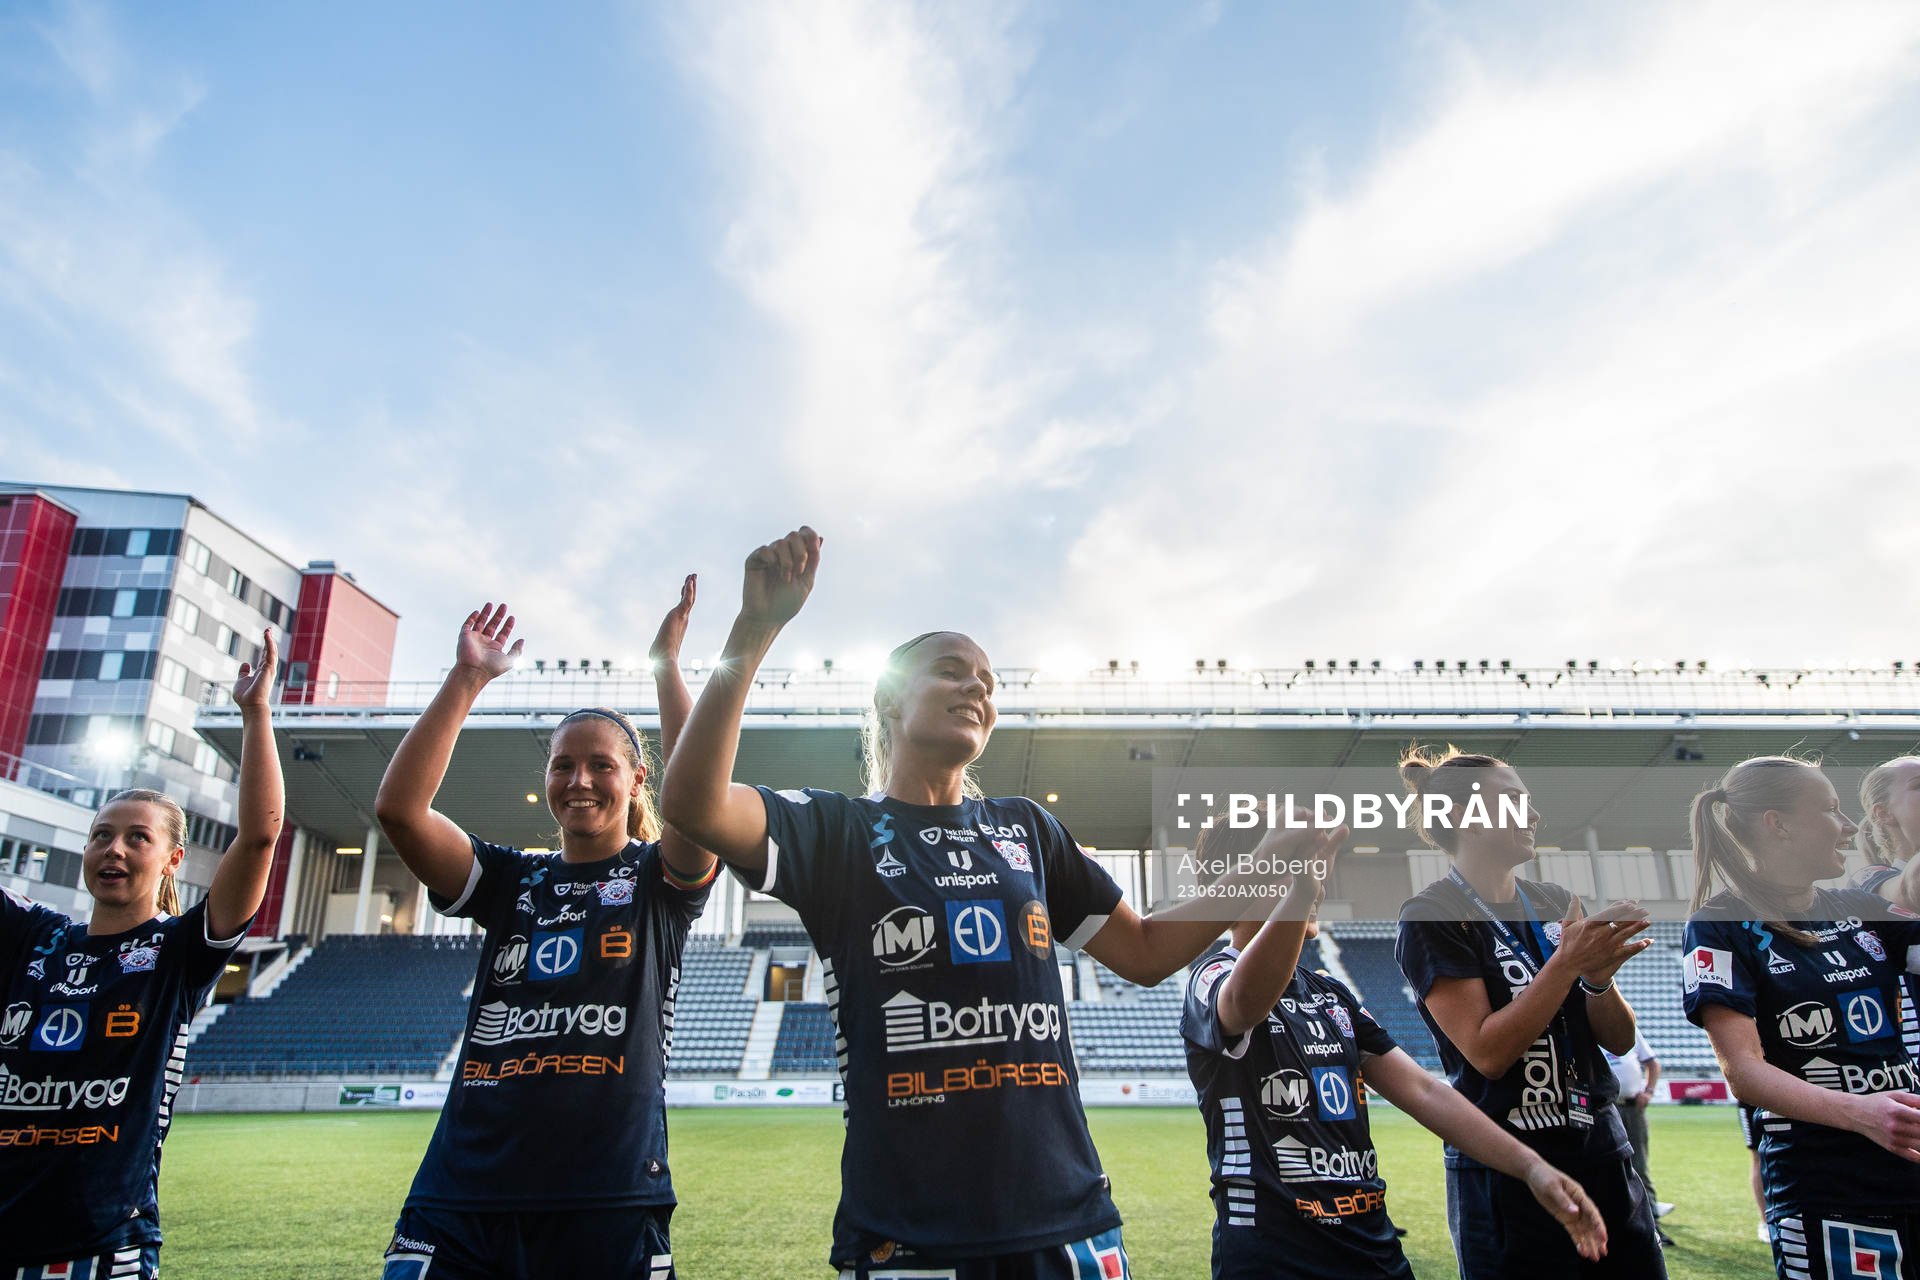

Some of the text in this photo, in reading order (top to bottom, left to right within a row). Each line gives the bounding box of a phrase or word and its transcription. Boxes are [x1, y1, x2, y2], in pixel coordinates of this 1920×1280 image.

[934, 872, 999, 889] unisport
[1768, 963, 1796, 974] SELECT
[1823, 966, 1872, 983] unisport
[503, 1002, 627, 1037] Botrygg
[929, 996, 1061, 1042] Botrygg
[1303, 1042, 1344, 1057] unisport
[463, 1052, 625, 1080] BILBÖRSEN
[4, 1074, 131, 1110] Botrygg
[0, 1124, 120, 1147] BÖRSEN
